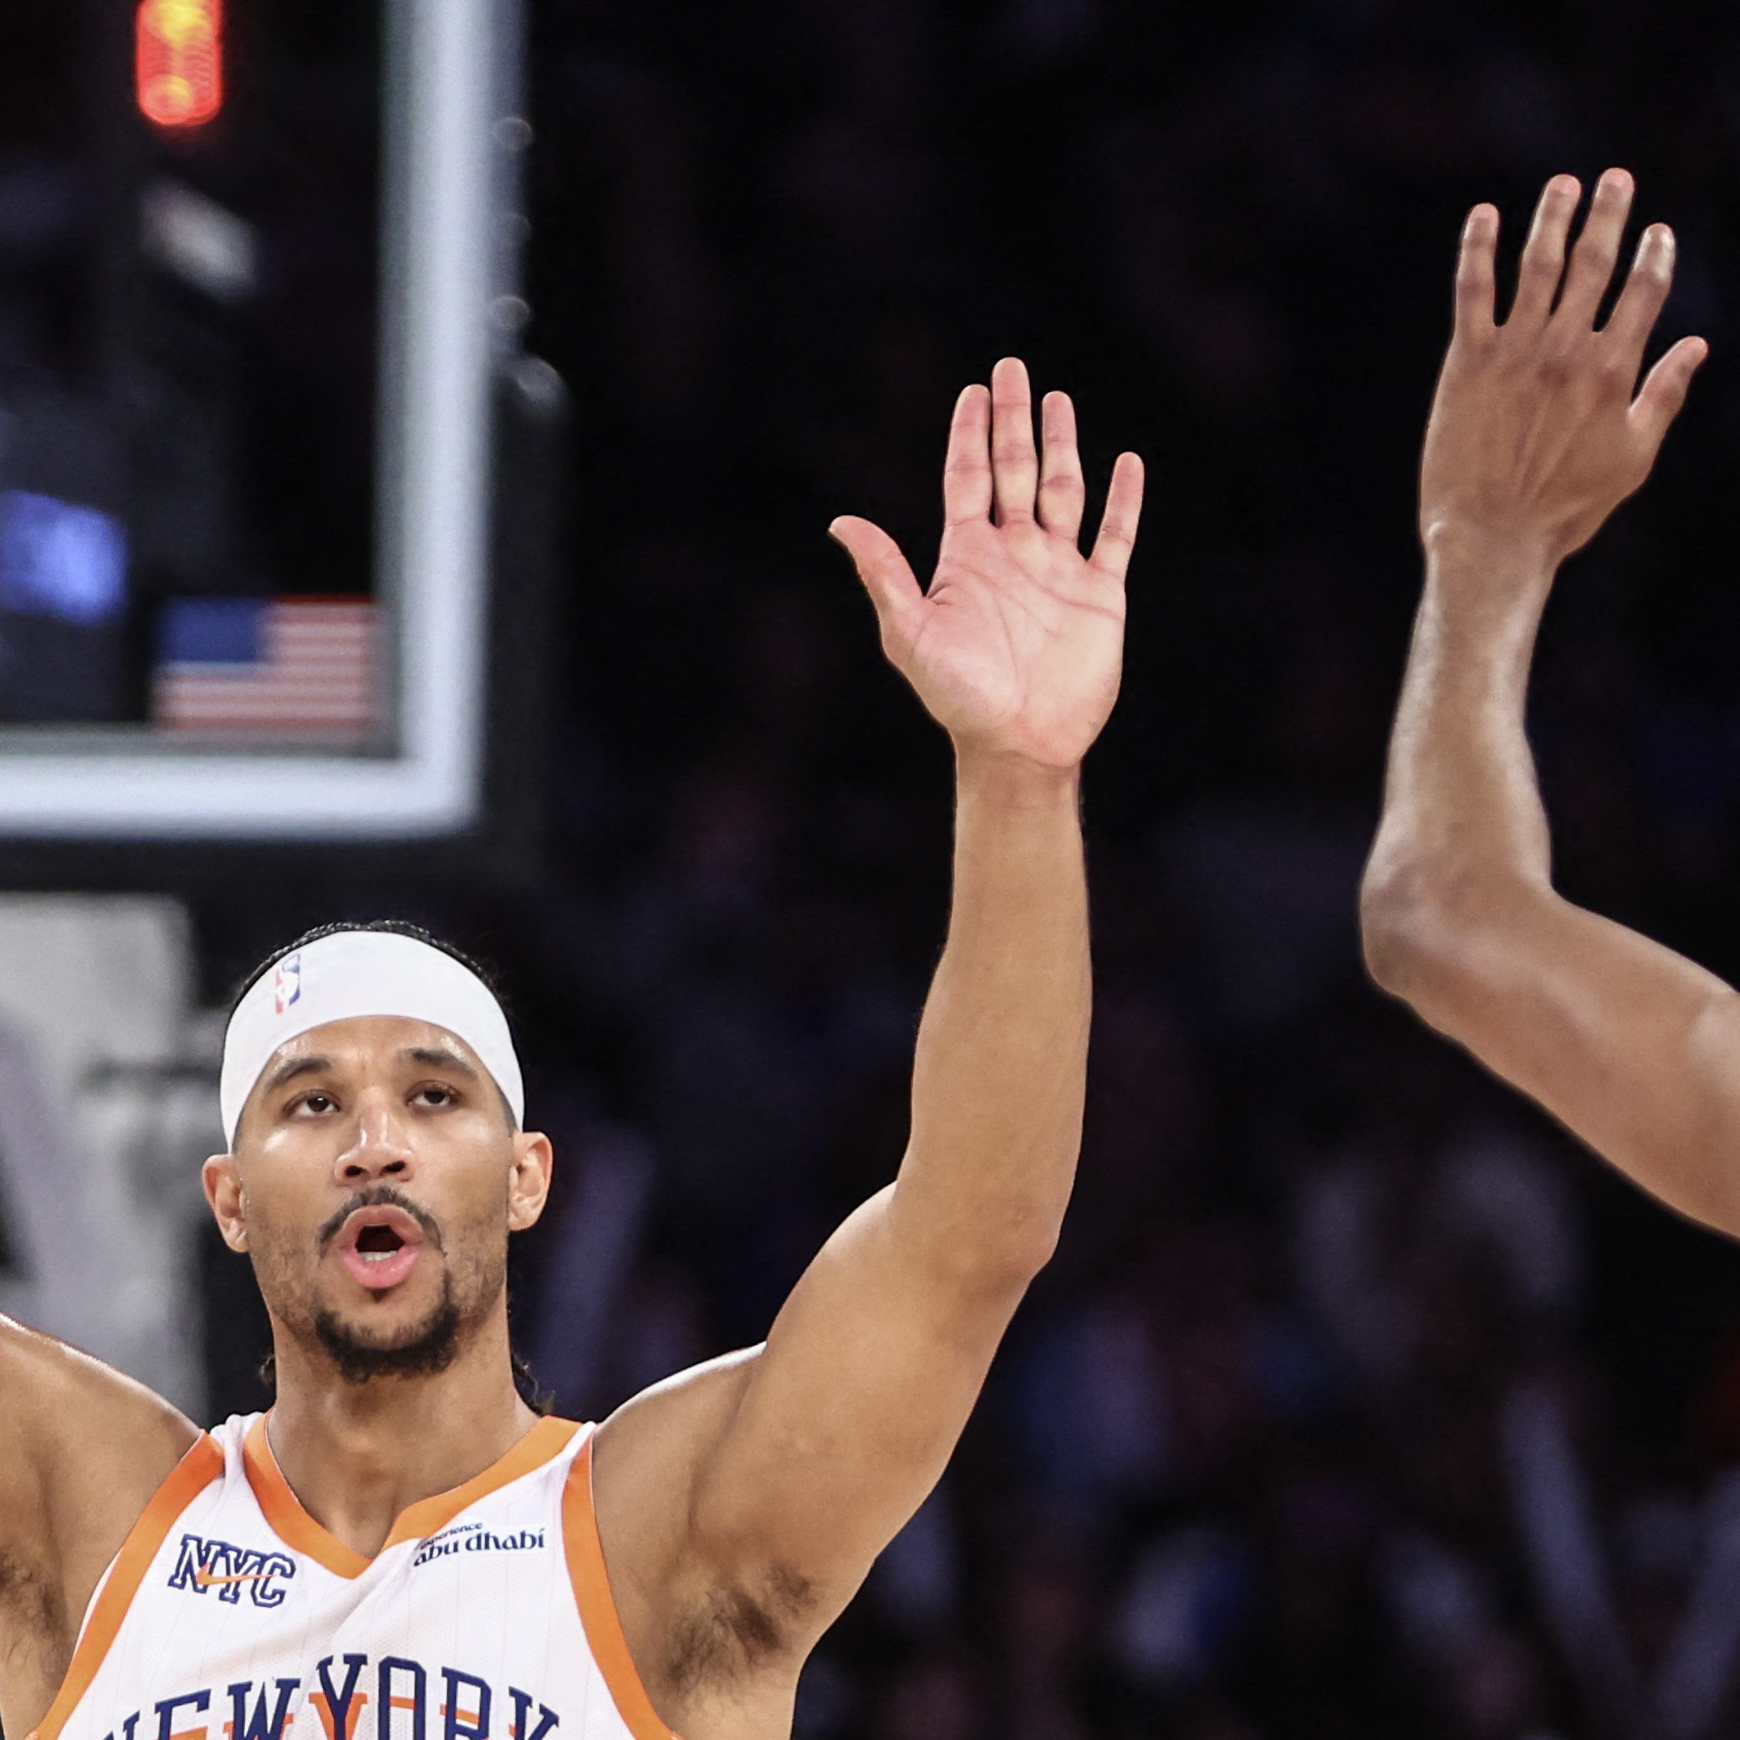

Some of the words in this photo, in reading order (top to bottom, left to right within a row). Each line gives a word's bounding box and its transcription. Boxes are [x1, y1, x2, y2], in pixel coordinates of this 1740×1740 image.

[167, 1533, 297, 1608] NYC
[413, 1540, 460, 1567] abu
[465, 1527, 546, 1552] dhabi
